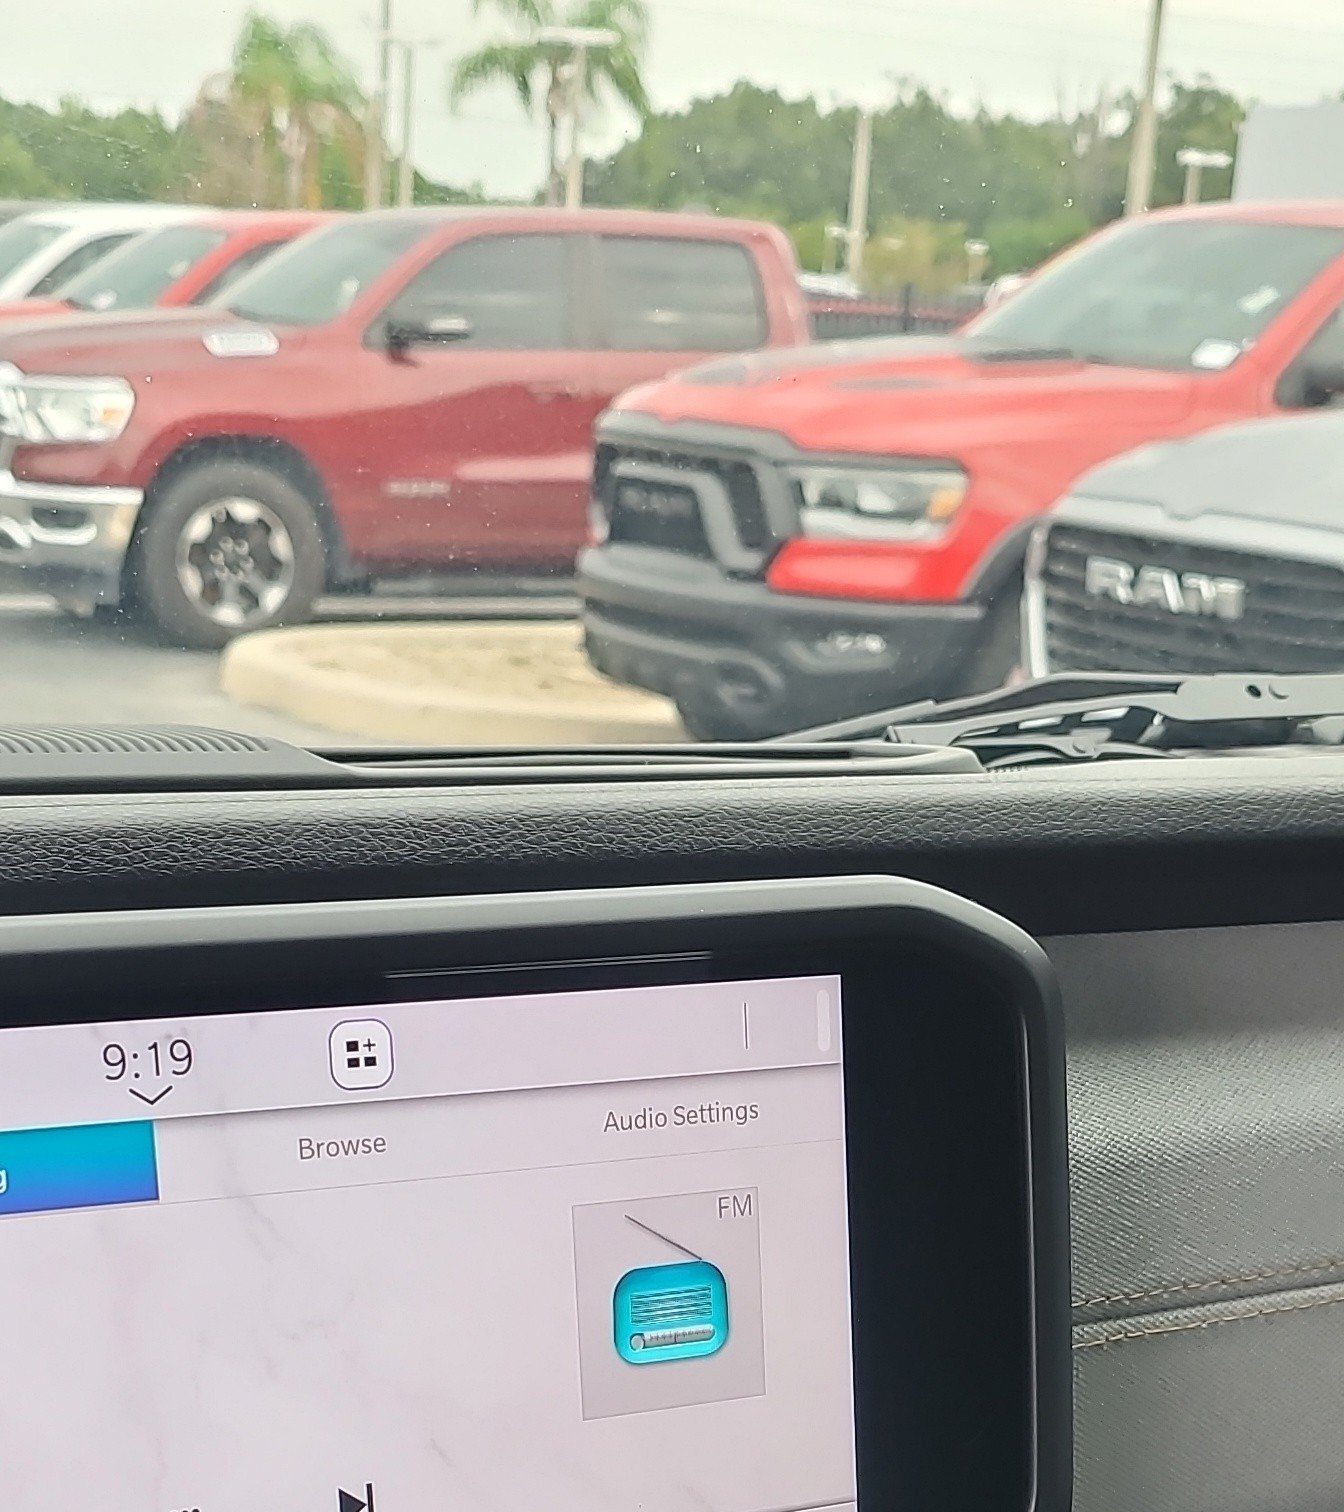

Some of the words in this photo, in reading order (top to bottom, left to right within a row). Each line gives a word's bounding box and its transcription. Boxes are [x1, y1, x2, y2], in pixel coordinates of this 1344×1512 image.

[1084, 555, 1248, 621] RAM
[102, 1036, 195, 1083] 9:19
[602, 1103, 668, 1133] Audio
[672, 1098, 760, 1134] Settings
[297, 1129, 387, 1161] Browse
[716, 1194, 754, 1220] FM
